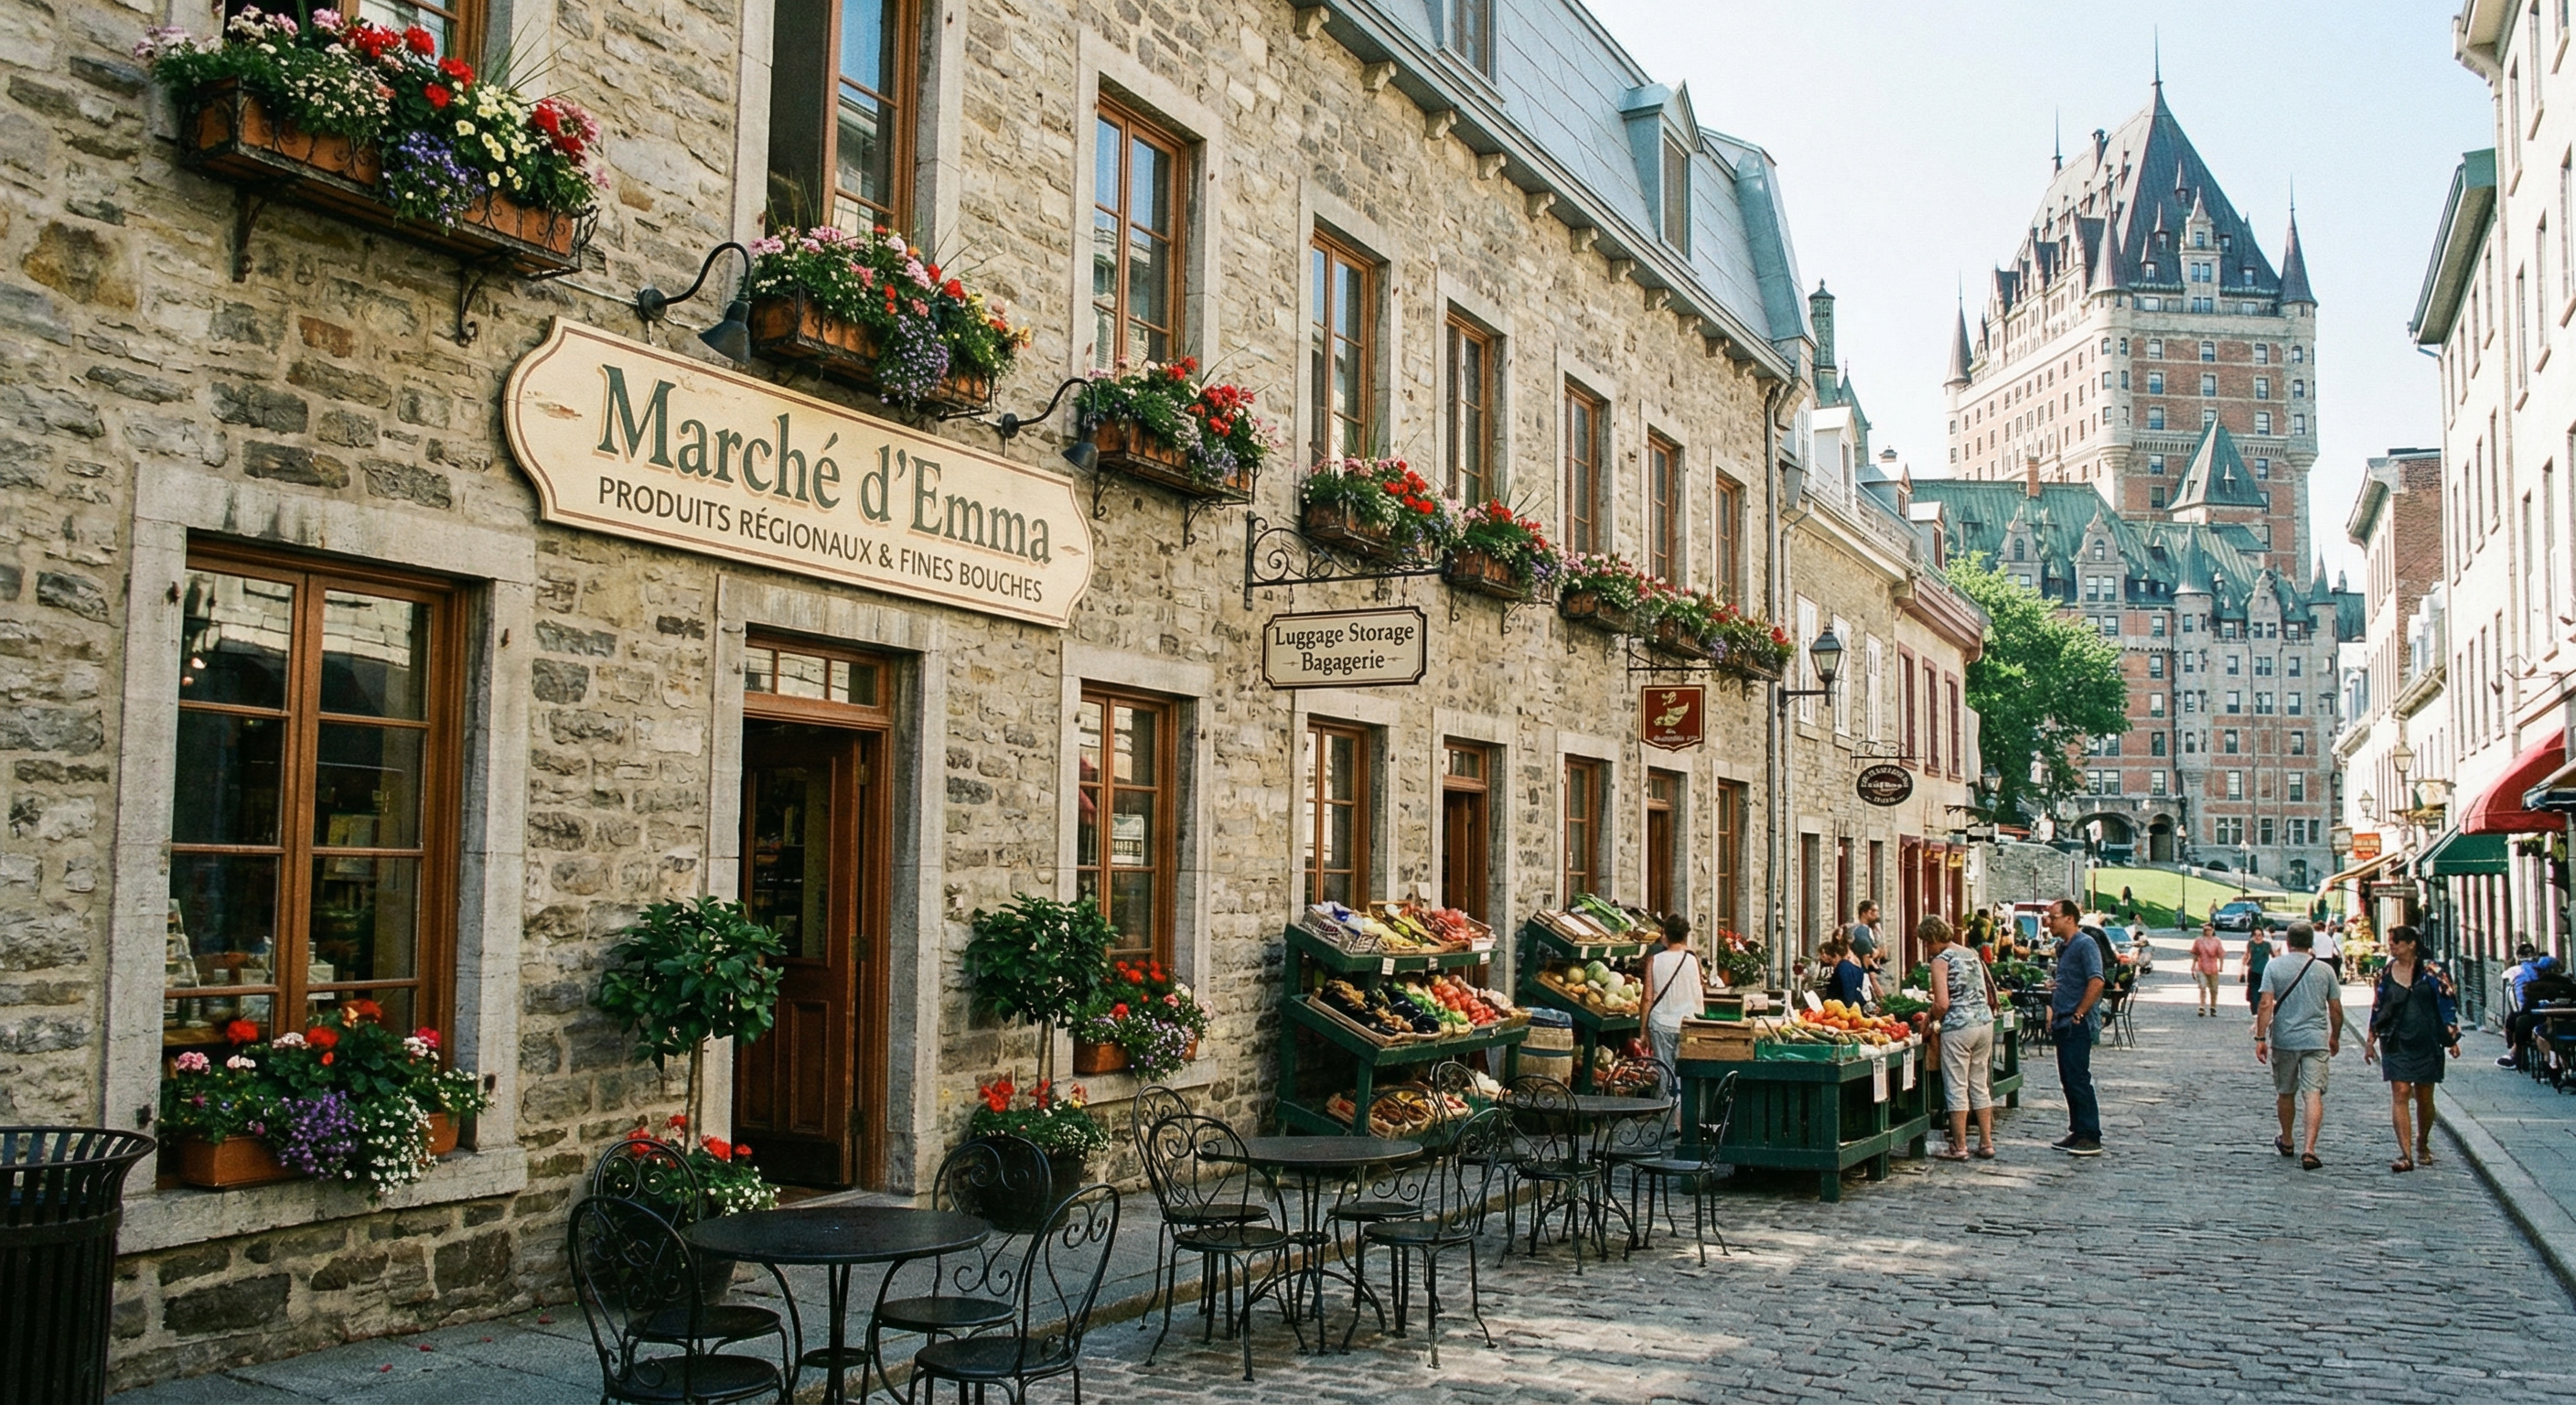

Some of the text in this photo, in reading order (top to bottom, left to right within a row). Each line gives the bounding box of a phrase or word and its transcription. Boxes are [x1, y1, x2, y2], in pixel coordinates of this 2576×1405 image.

[596, 363, 1052, 563] Marché d'Emma
[598, 477, 1043, 603] PRODUITS RÉGIONAUX & FINES BOUCHES
[1274, 622, 1414, 649] Luggage Storage
[1301, 649, 1385, 675] Bagagerie
